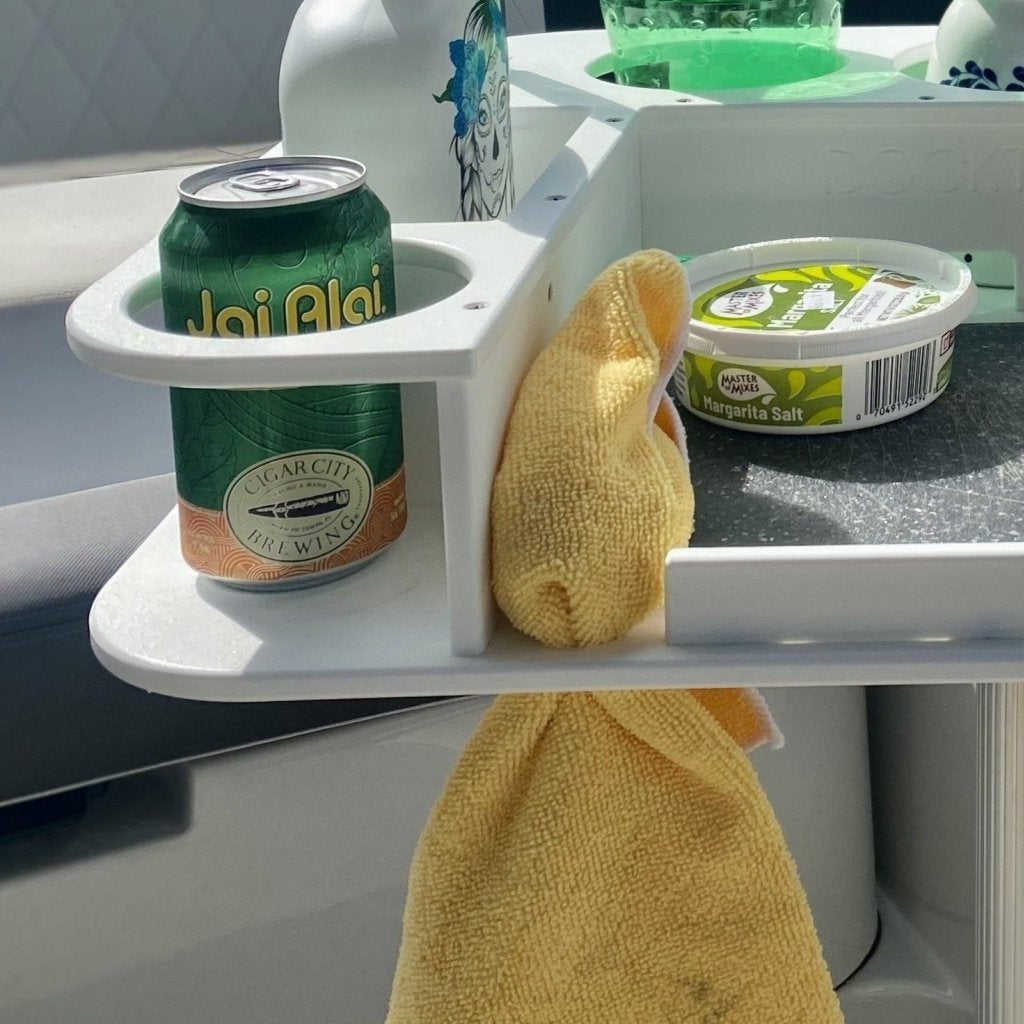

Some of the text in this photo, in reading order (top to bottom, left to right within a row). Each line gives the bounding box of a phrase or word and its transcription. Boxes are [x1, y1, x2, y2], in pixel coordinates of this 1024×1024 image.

[186, 287, 273, 339] Jai
[766, 282, 834, 328] Marta
[720, 374, 758, 387] MASTER
[731, 383, 760, 395] MIXES
[703, 395, 804, 422] Margarita Salt
[244, 459, 356, 495] CIGAR CITY
[247, 515, 356, 556] BREWING
